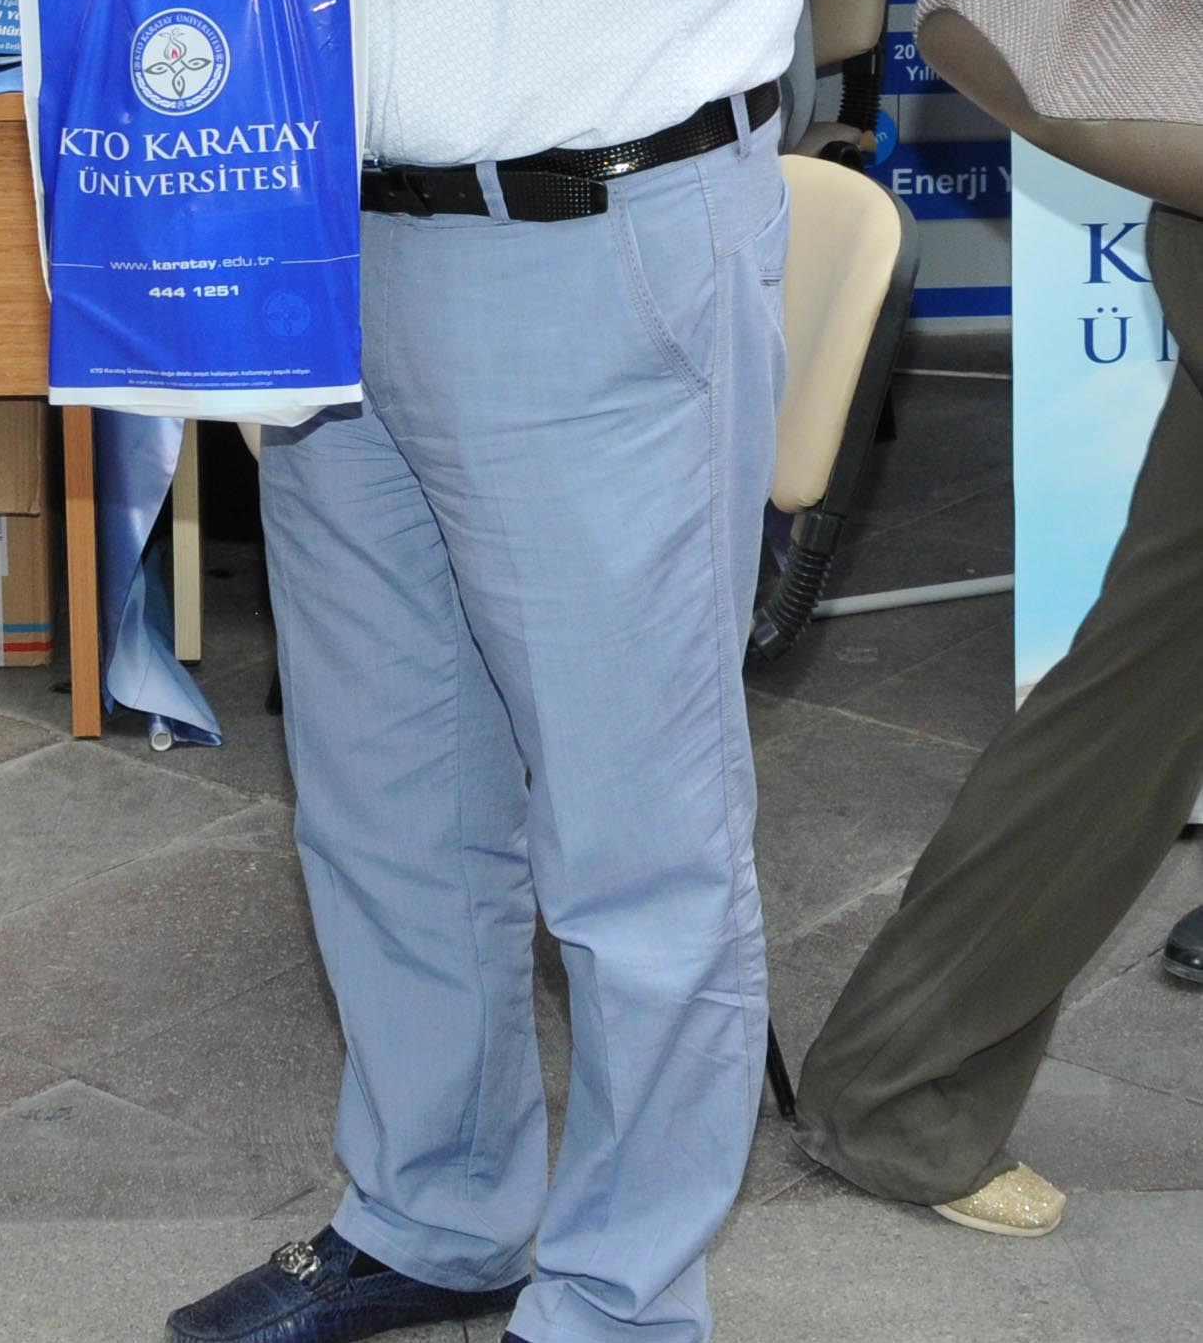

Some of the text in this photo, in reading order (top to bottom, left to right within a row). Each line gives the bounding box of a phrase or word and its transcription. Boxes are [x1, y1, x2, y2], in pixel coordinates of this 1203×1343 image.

[58, 120, 322, 162] KTO KARATAY
[78, 159, 301, 198] ÜNİVERSİTESİ
[892, 166, 988, 201] Enerji
[109, 255, 275, 272] www.karatay.edu.tr
[148, 284, 241, 298] 444 1251
